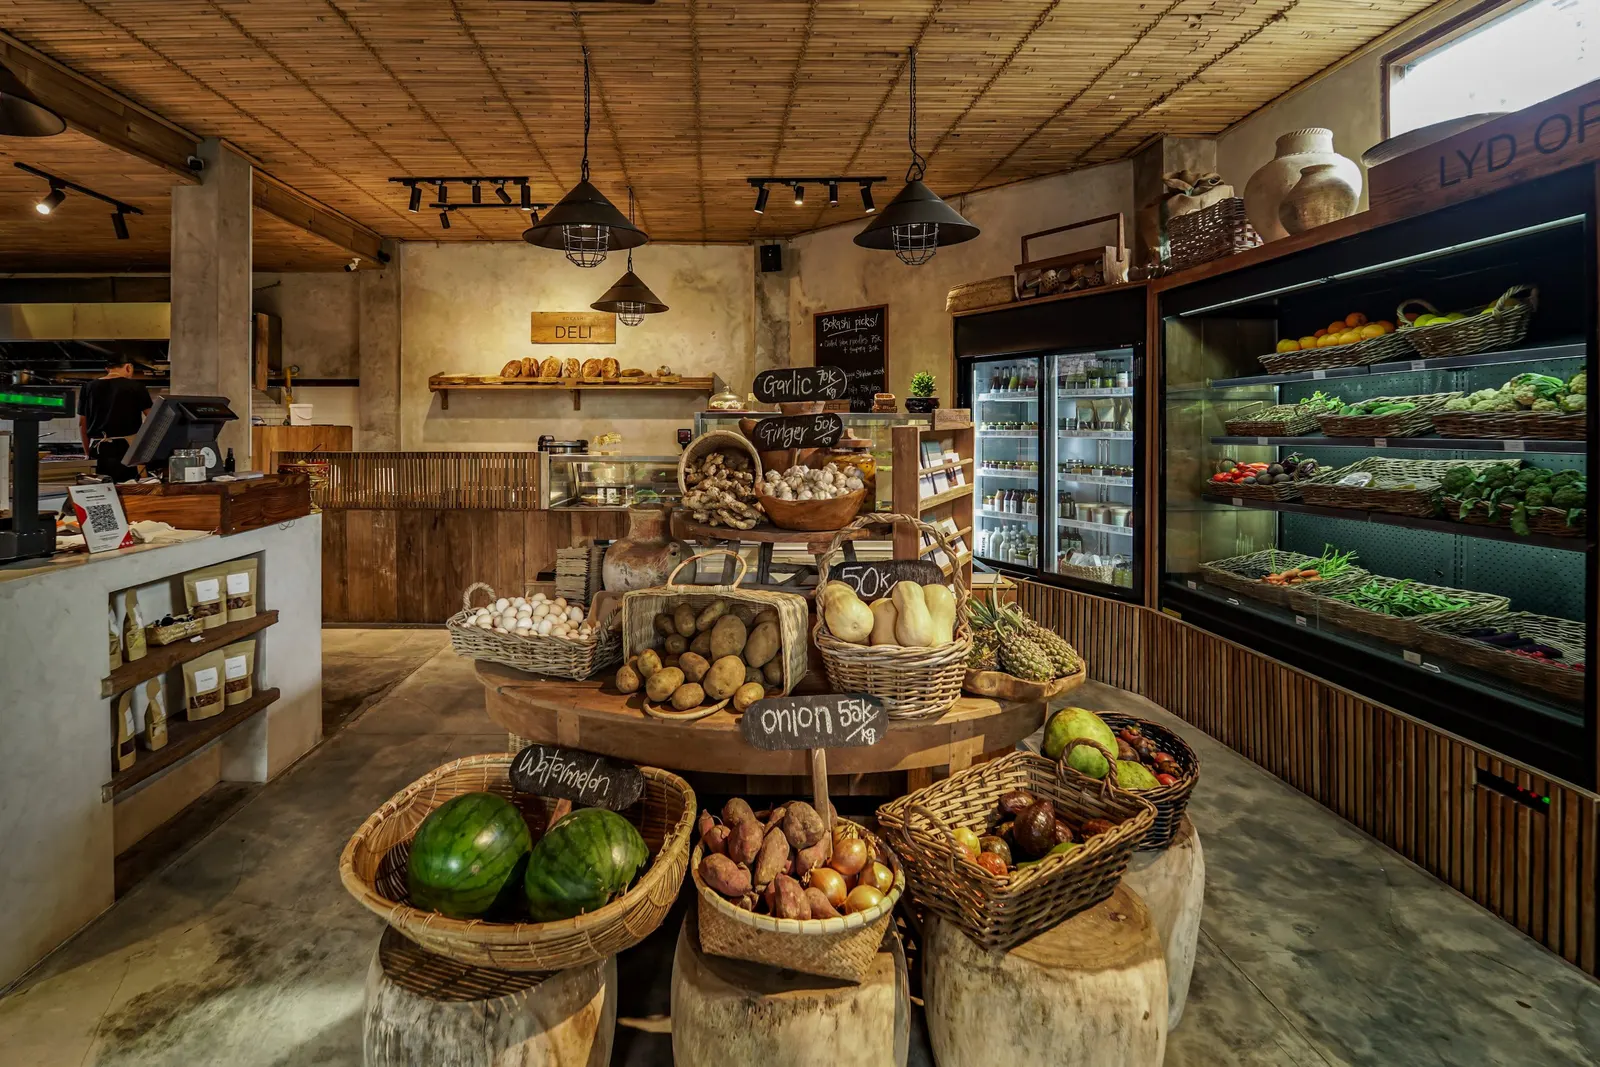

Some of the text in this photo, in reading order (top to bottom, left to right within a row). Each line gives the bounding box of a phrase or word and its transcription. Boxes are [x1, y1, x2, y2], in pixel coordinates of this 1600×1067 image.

[1440, 133, 1517, 188] LYD
[555, 325, 592, 339] DELI
[855, 313, 879, 332] picks!
[763, 370, 813, 397] Garlic
[760, 420, 809, 448] Ginger
[761, 702, 833, 737] onion
[518, 747, 611, 798] Watermelon
